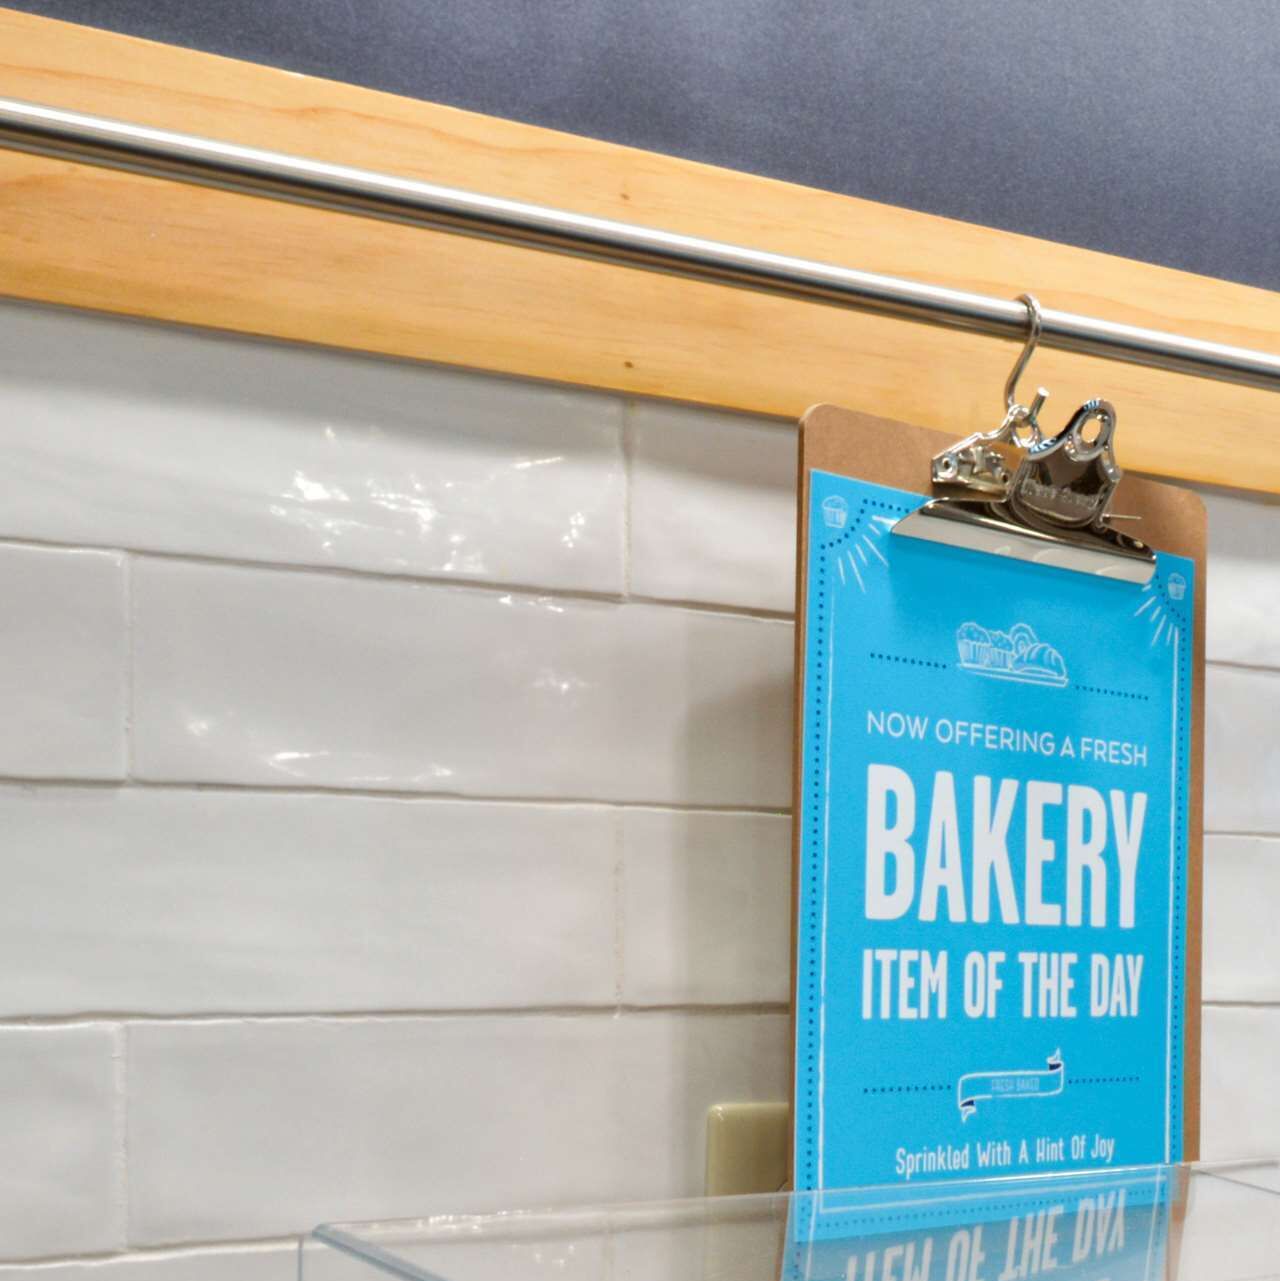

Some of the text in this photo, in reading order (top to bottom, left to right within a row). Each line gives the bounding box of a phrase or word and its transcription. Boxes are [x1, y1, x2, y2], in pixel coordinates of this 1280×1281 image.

[867, 710, 1148, 767] NOW OFFERING A FRESH
[865, 762, 1148, 929] BAKERY
[862, 949, 1144, 1020] ITEM OF THE DAY
[896, 1133, 1115, 1180] Sprinkled With A Hint Of Joy
